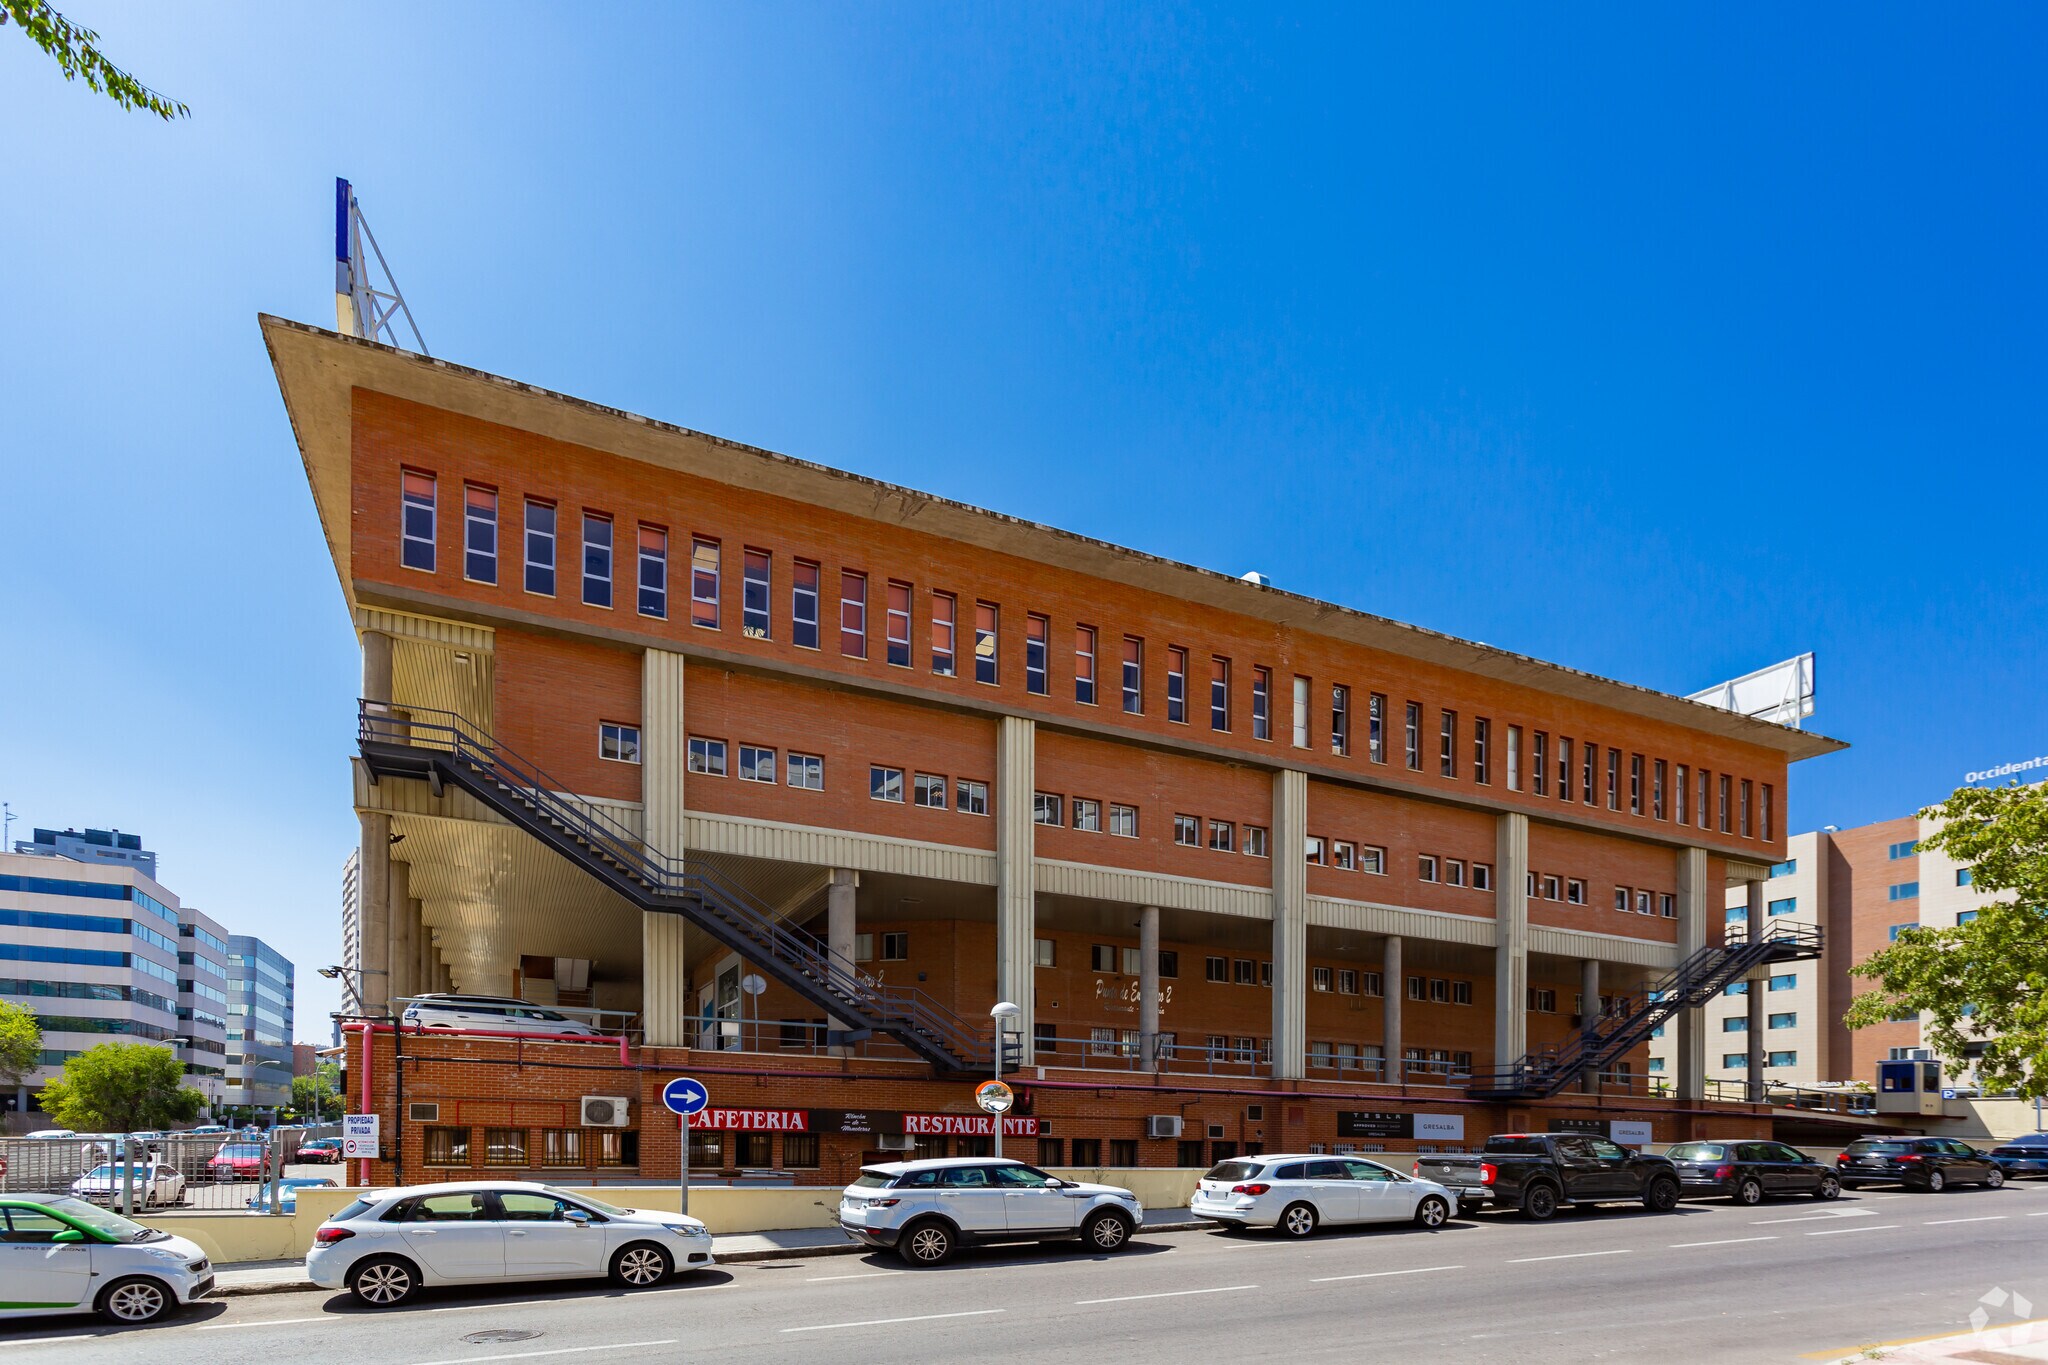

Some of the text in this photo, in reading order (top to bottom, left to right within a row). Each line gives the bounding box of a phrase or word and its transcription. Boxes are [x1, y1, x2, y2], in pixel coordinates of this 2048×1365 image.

[1165, 985, 1173, 1004] 2
[347, 1116, 374, 1124] PROPIEDAD
[1353, 1112, 1401, 1120] TESLA
[1422, 1123, 1456, 1131] GRESALBA
